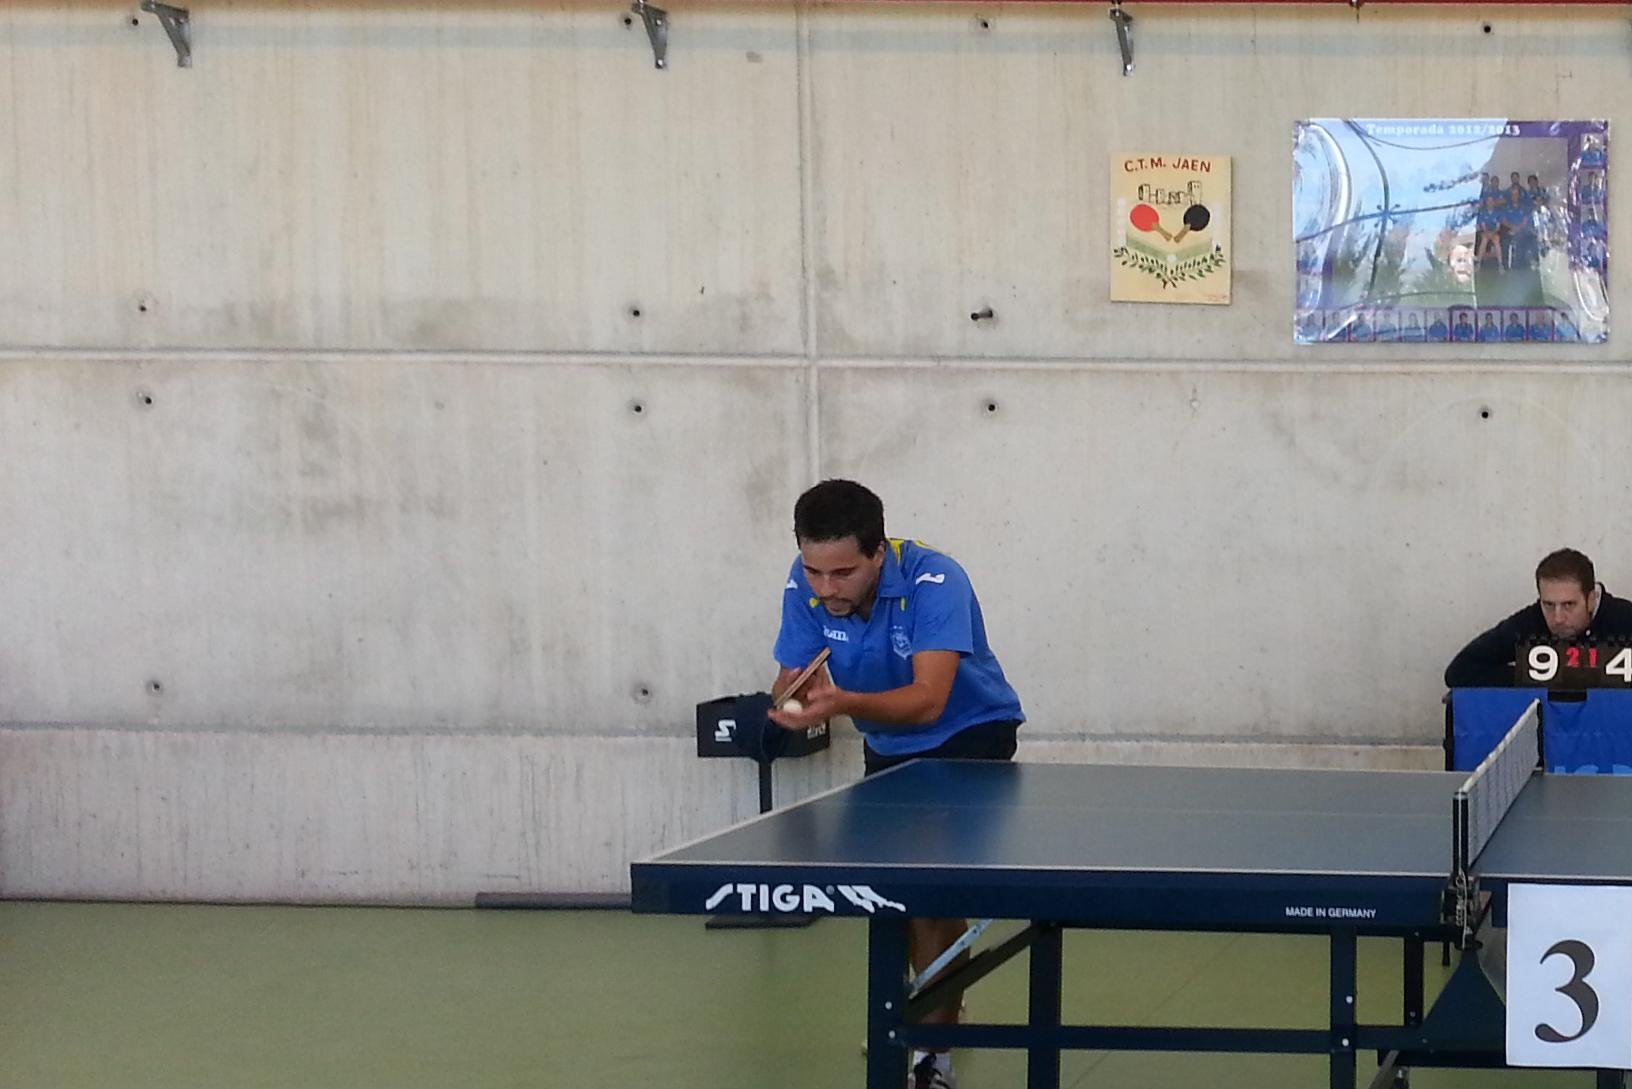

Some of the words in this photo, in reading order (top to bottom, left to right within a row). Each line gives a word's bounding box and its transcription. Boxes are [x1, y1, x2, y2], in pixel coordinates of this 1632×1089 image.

[1366, 124, 1444, 136] Temporada
[1172, 157, 1211, 173] JAEN
[1528, 645, 1559, 682] 9
[1565, 647, 1580, 668] 2
[1588, 647, 1598, 668] 1
[705, 883, 835, 913] STIGA
[1285, 906, 1314, 917] MADE
[1315, 907, 1327, 917] IN
[1328, 907, 1376, 919] GERMANY
[1535, 939, 1600, 1043] 3
